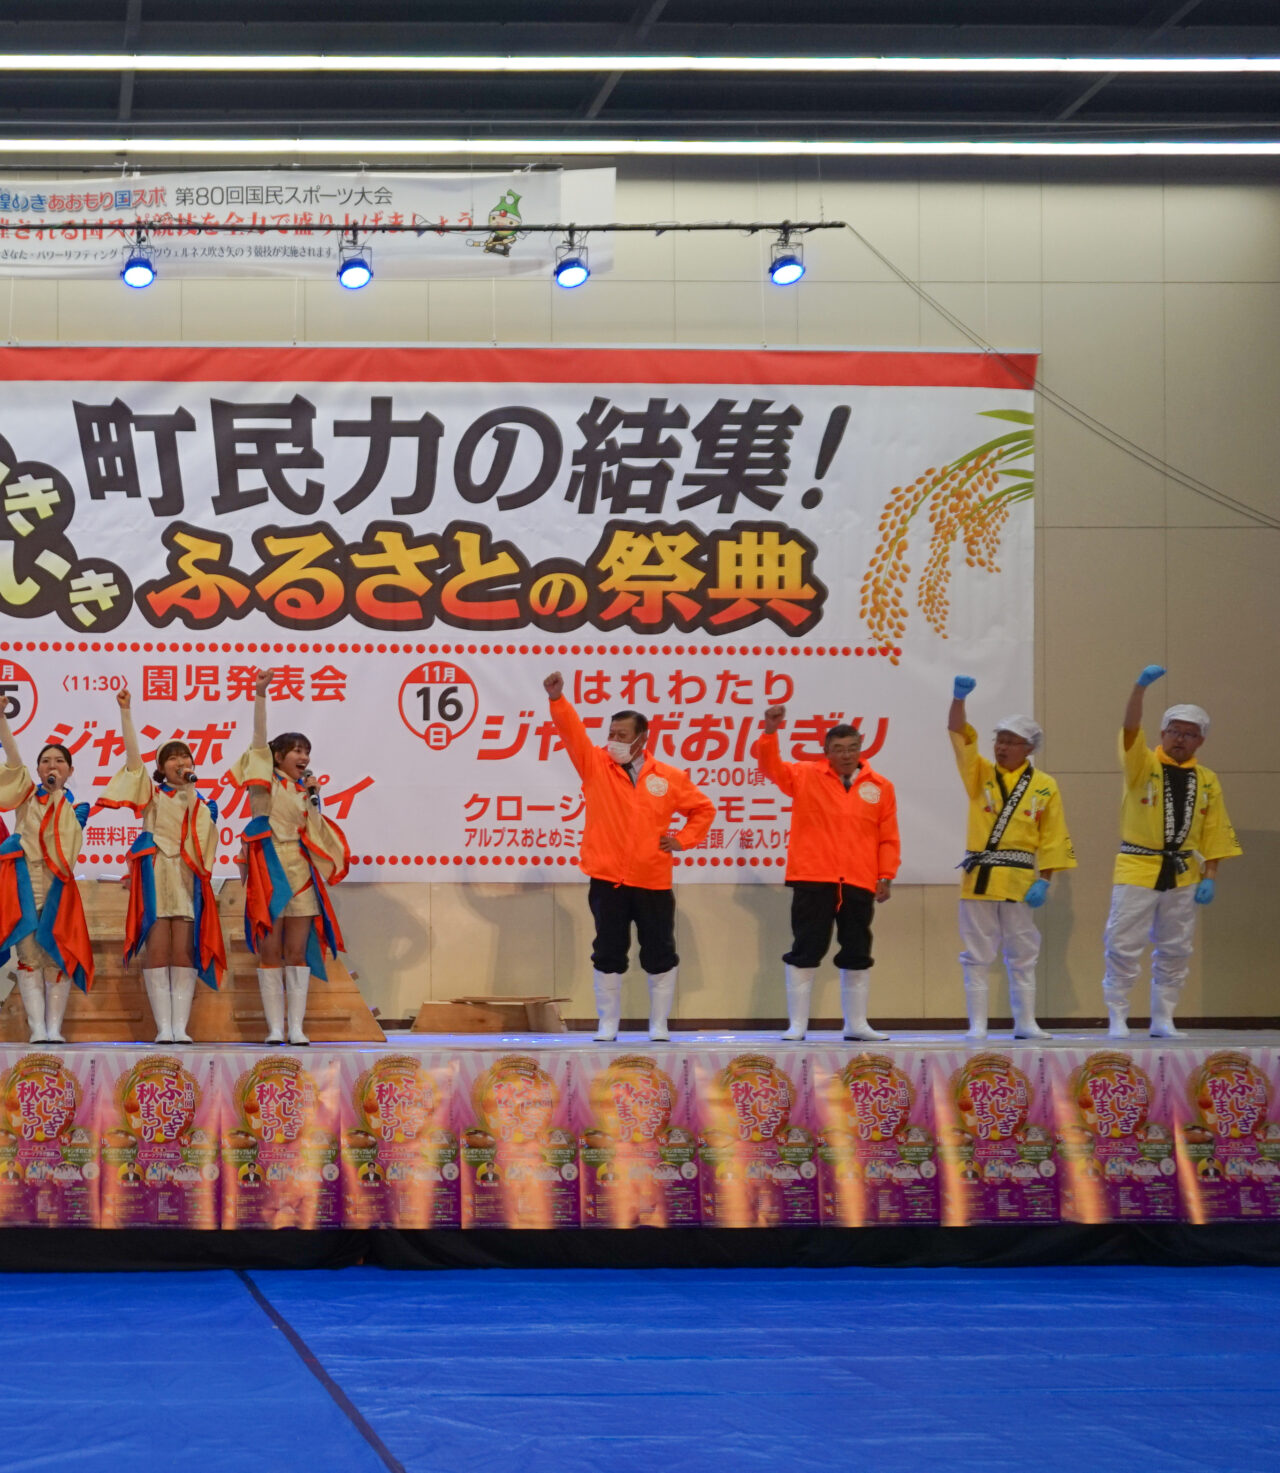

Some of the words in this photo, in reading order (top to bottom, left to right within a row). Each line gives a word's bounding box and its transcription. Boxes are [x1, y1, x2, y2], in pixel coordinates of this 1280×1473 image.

[175, 185, 393, 207] 第80回国民スポーツ大会
[142, 526, 820, 629] ふるさとの祭典
[141, 664, 348, 703] 園児発表会
[422, 665, 456, 682] 11月
[573, 669, 795, 706] はれわたり
[416, 686, 464, 722] 16
[429, 727, 448, 747] 日
